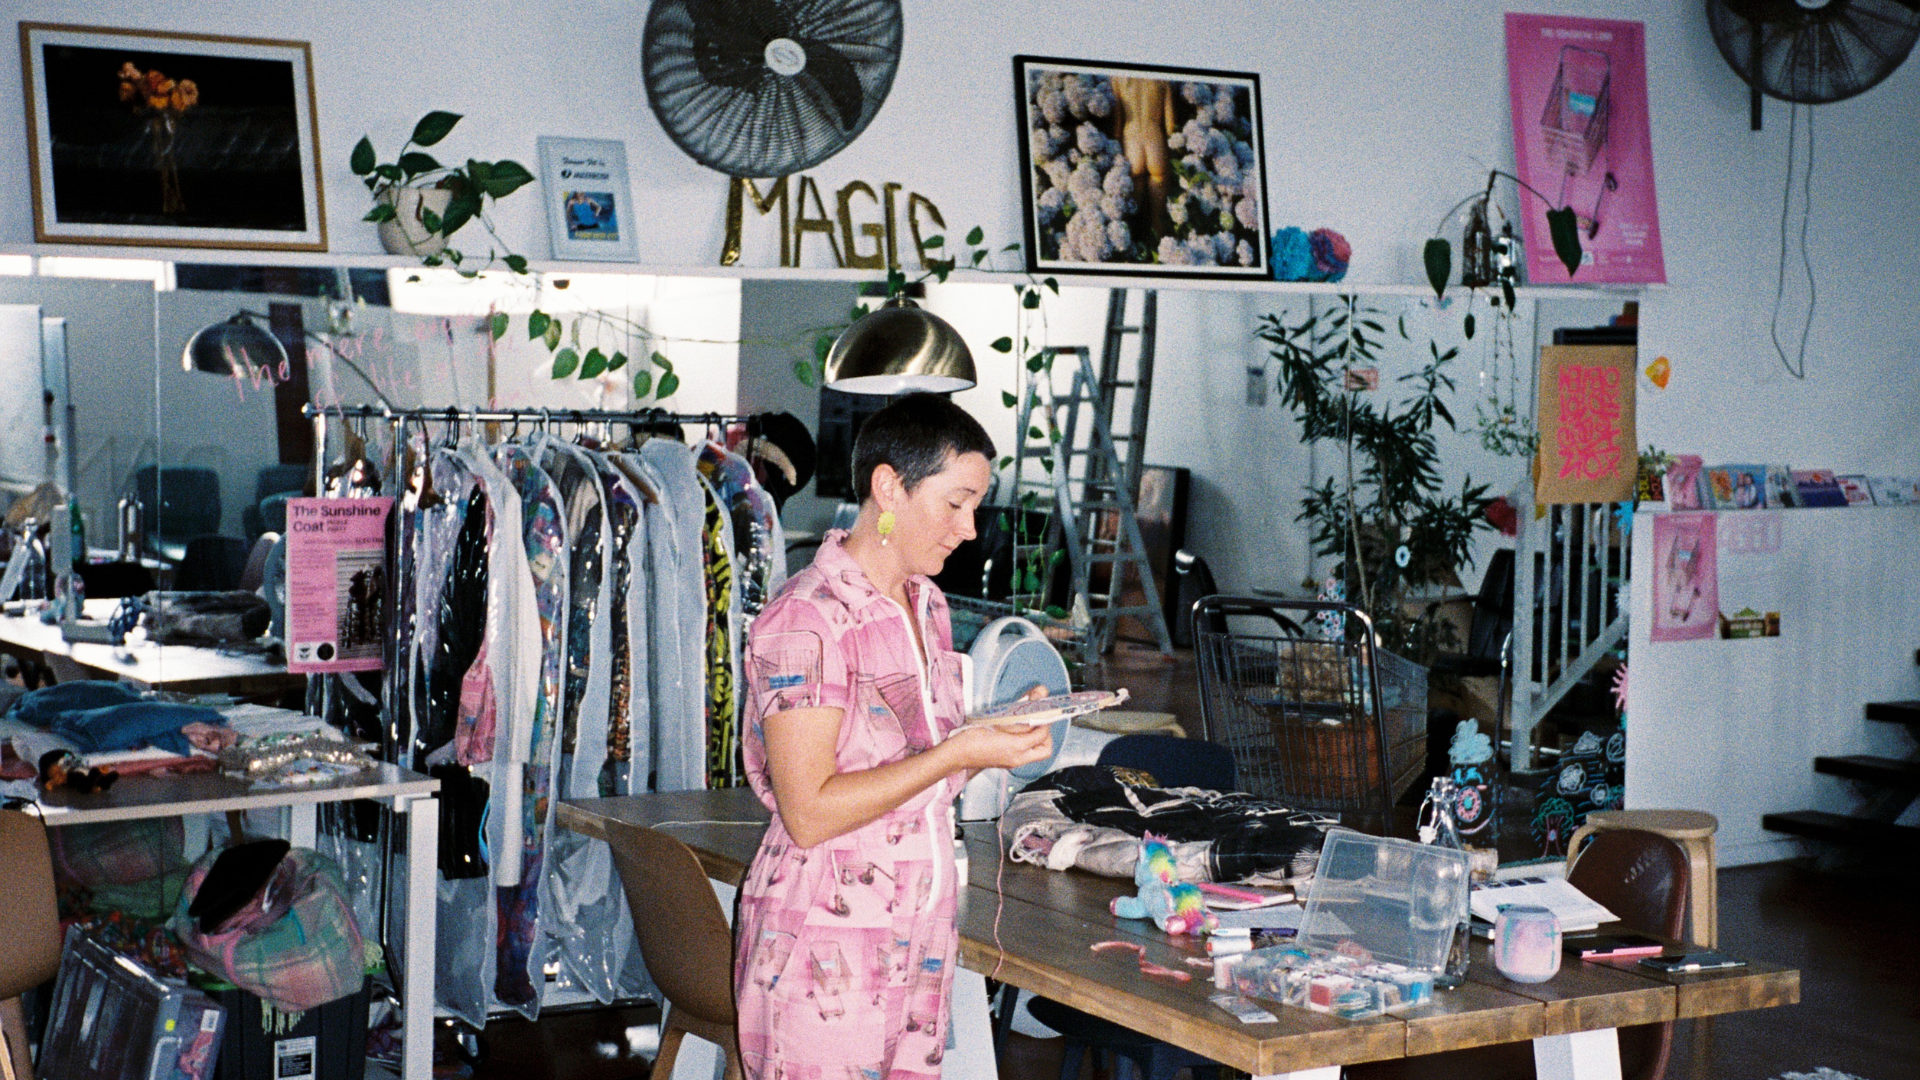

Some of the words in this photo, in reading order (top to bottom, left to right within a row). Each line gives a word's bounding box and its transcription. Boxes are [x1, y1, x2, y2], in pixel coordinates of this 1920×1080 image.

[720, 175, 947, 269] MAGIC
[293, 506, 318, 517] The
[321, 504, 381, 517] Sunshine
[293, 521, 324, 532] Coat
